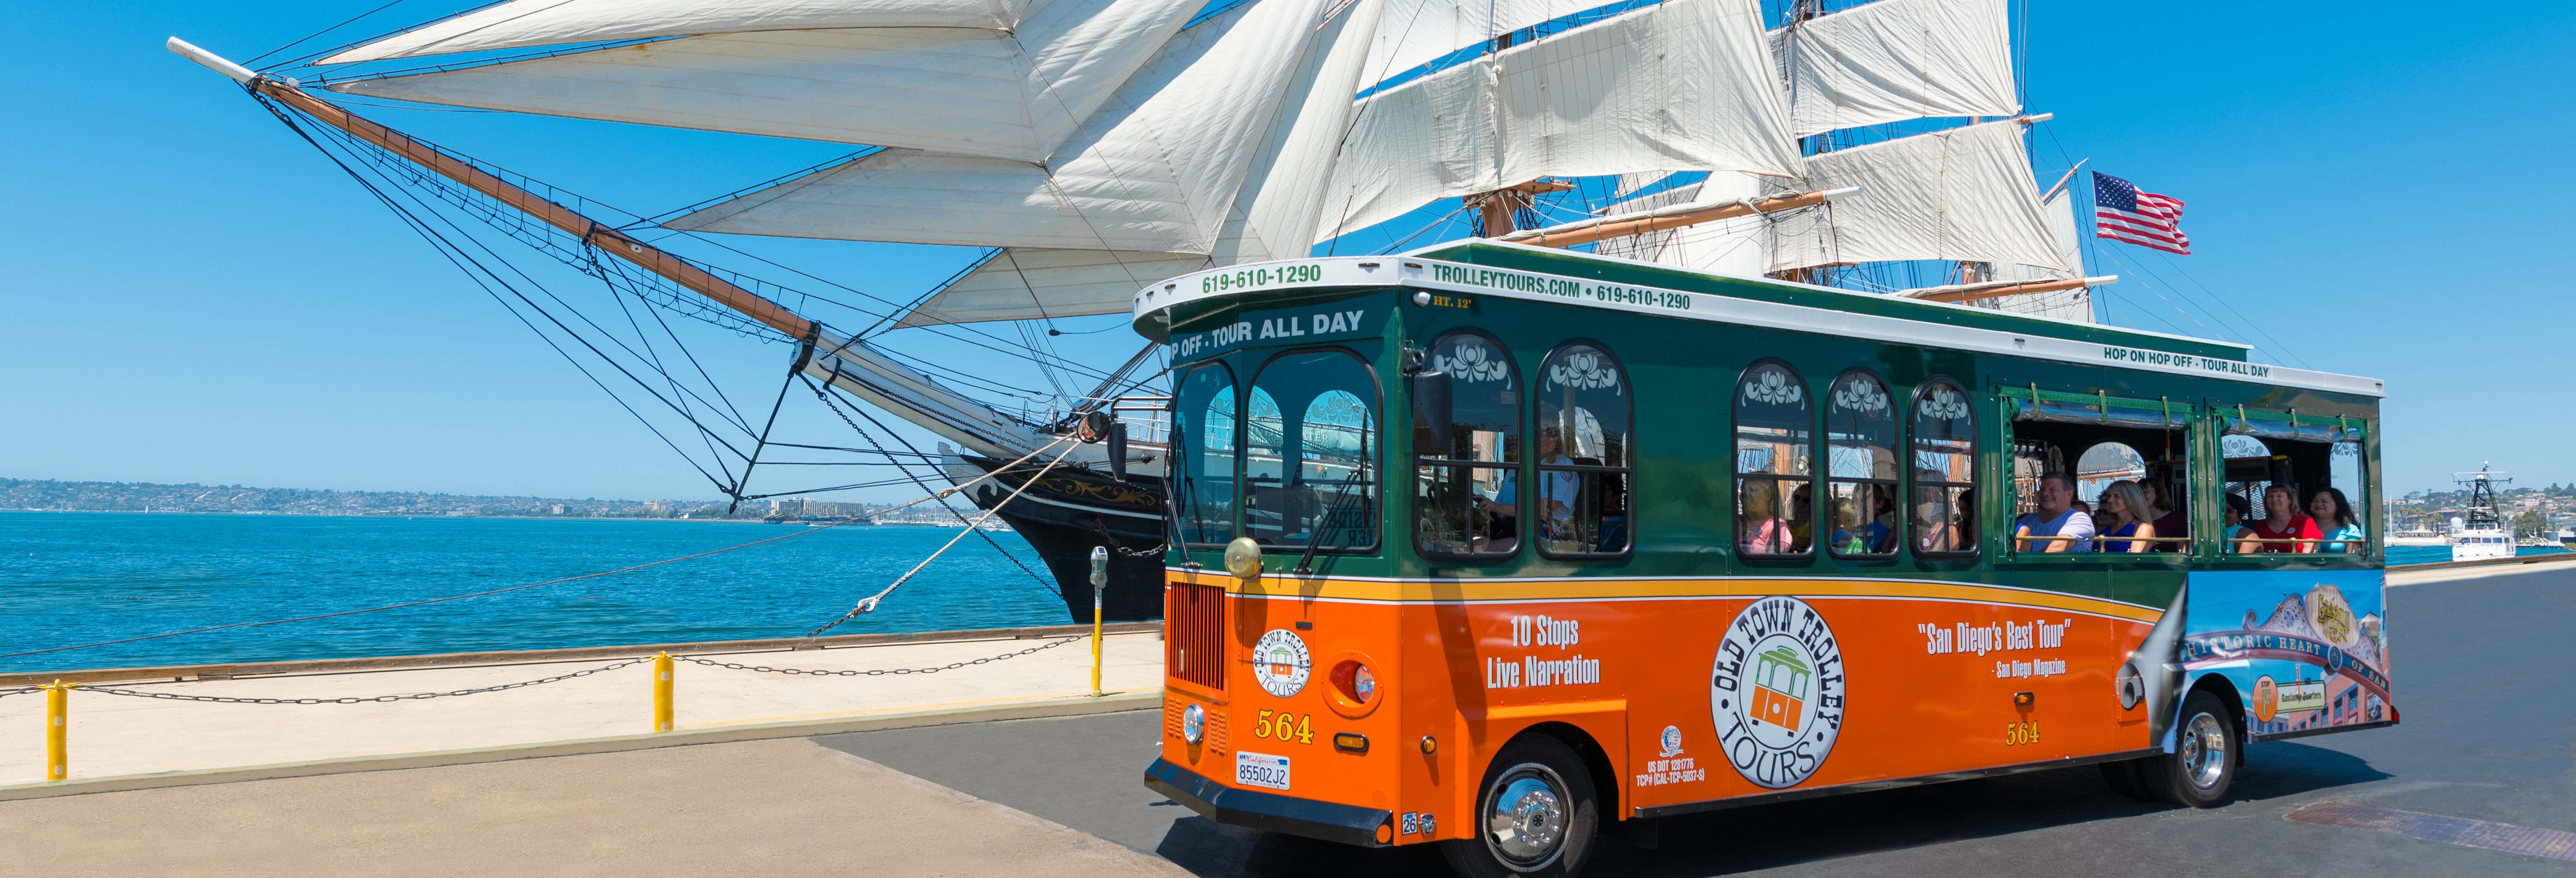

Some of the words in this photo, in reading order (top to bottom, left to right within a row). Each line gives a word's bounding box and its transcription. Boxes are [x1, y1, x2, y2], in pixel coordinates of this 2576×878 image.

[1203, 264, 1321, 293] 619-610-1290
[1433, 264, 1580, 298] TROLLEYTOURS.COM
[1597, 285, 1690, 310] 619-610-1290
[1433, 296, 1453, 307] HT.
[1181, 334, 1202, 357] OFF
[1212, 321, 1251, 348] TOUR
[1259, 316, 1304, 339] ALL
[1313, 310, 1364, 334] DAY
[2104, 347, 2127, 360] HOP
[2130, 350, 2145, 363] ON
[2149, 352, 2170, 365] HOP
[2174, 354, 2193, 368] OFF
[2201, 358, 2227, 372] TOUR
[2231, 361, 2248, 375] ALL
[2251, 364, 2269, 378] DAY
[1303, 432, 1328, 443] ATER
[1511, 615, 1531, 647] 10
[1537, 615, 1579, 650] Stops
[1918, 623, 1952, 655] "San
[1957, 621, 2002, 657] Diego's
[2007, 621, 2033, 650] Best
[2037, 618, 2071, 648] Tour"
[1254, 650, 1264, 668] OLD
[1259, 631, 1281, 650] TOWN
[1285, 631, 1309, 672] TROLLEY
[1714, 638, 1745, 692] OLD
[1736, 599, 1795, 646] TOWN
[1798, 608, 1843, 730] TROLLEY
[2185, 635, 2271, 657] HISTORIC
[2279, 637, 2320, 655] HEART
[2352, 660, 2364, 673] OF
[2369, 670, 2386, 689] SAN
[1487, 657, 1520, 689] Live
[1525, 654, 1600, 686] Narration
[1997, 661, 2010, 678] San
[2012, 660, 2032, 679] Diego
[2034, 658, 2066, 678] Magazine
[1262, 674, 1302, 697] TOURS
[2262, 689, 2271, 716] F
[1254, 709, 1315, 745] 564
[2006, 720, 2040, 746] 564
[1246, 755, 1280, 766] California
[1722, 711, 1816, 785] TOURS
[1240, 764, 1285, 785] 85502J2
[1636, 774, 1653, 786] TCP#
[1648, 761, 1656, 773] US
[1657, 760, 1669, 772] DOT
[1670, 758, 1694, 770] 1281776
[1404, 818, 1416, 833] 26
